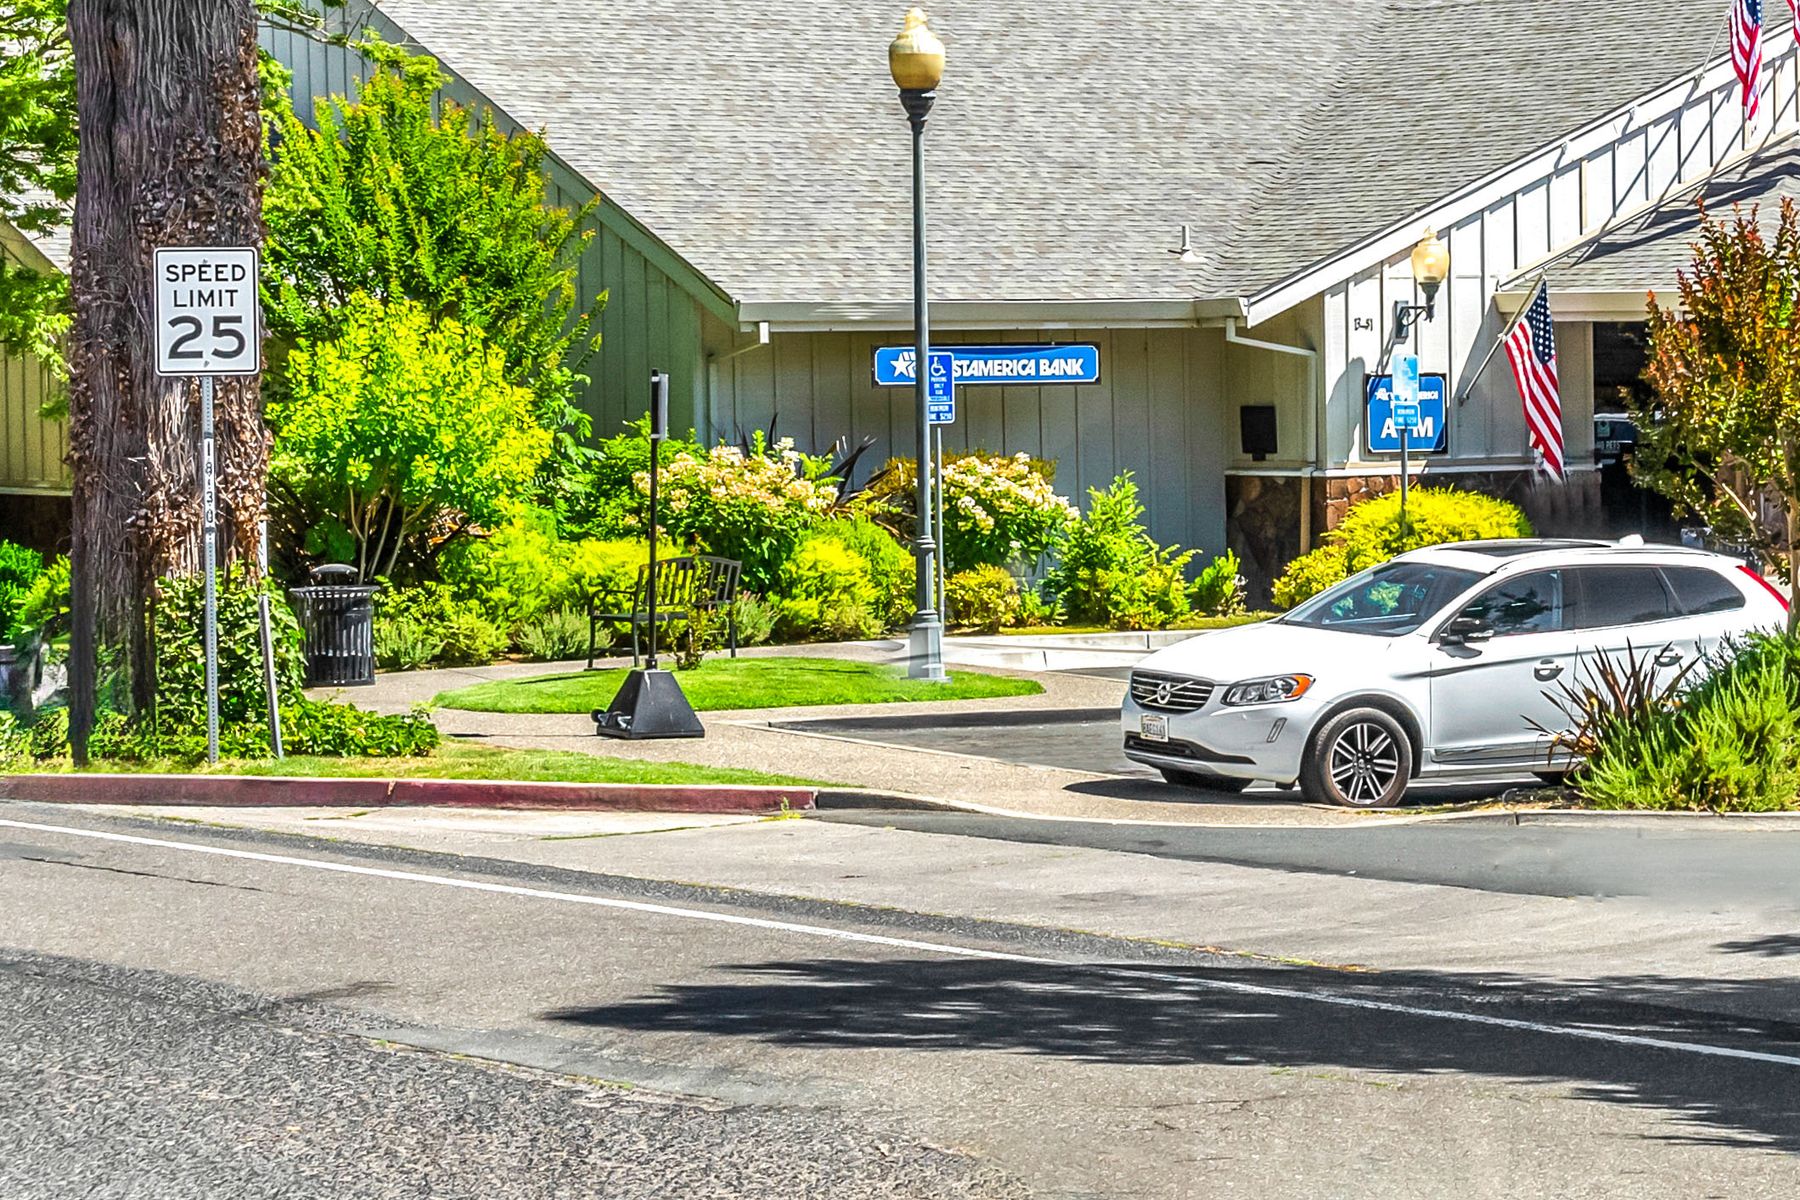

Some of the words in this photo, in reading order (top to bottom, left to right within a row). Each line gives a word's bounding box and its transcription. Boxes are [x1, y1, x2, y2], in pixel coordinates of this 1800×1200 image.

[166, 264, 246, 282] SPEED
[174, 289, 238, 307] LIMIT
[168, 315, 246, 359] 25
[953, 359, 1035, 377] STAMERICA
[1039, 358, 1084, 376] BANK
[1380, 416, 1434, 438] AM
